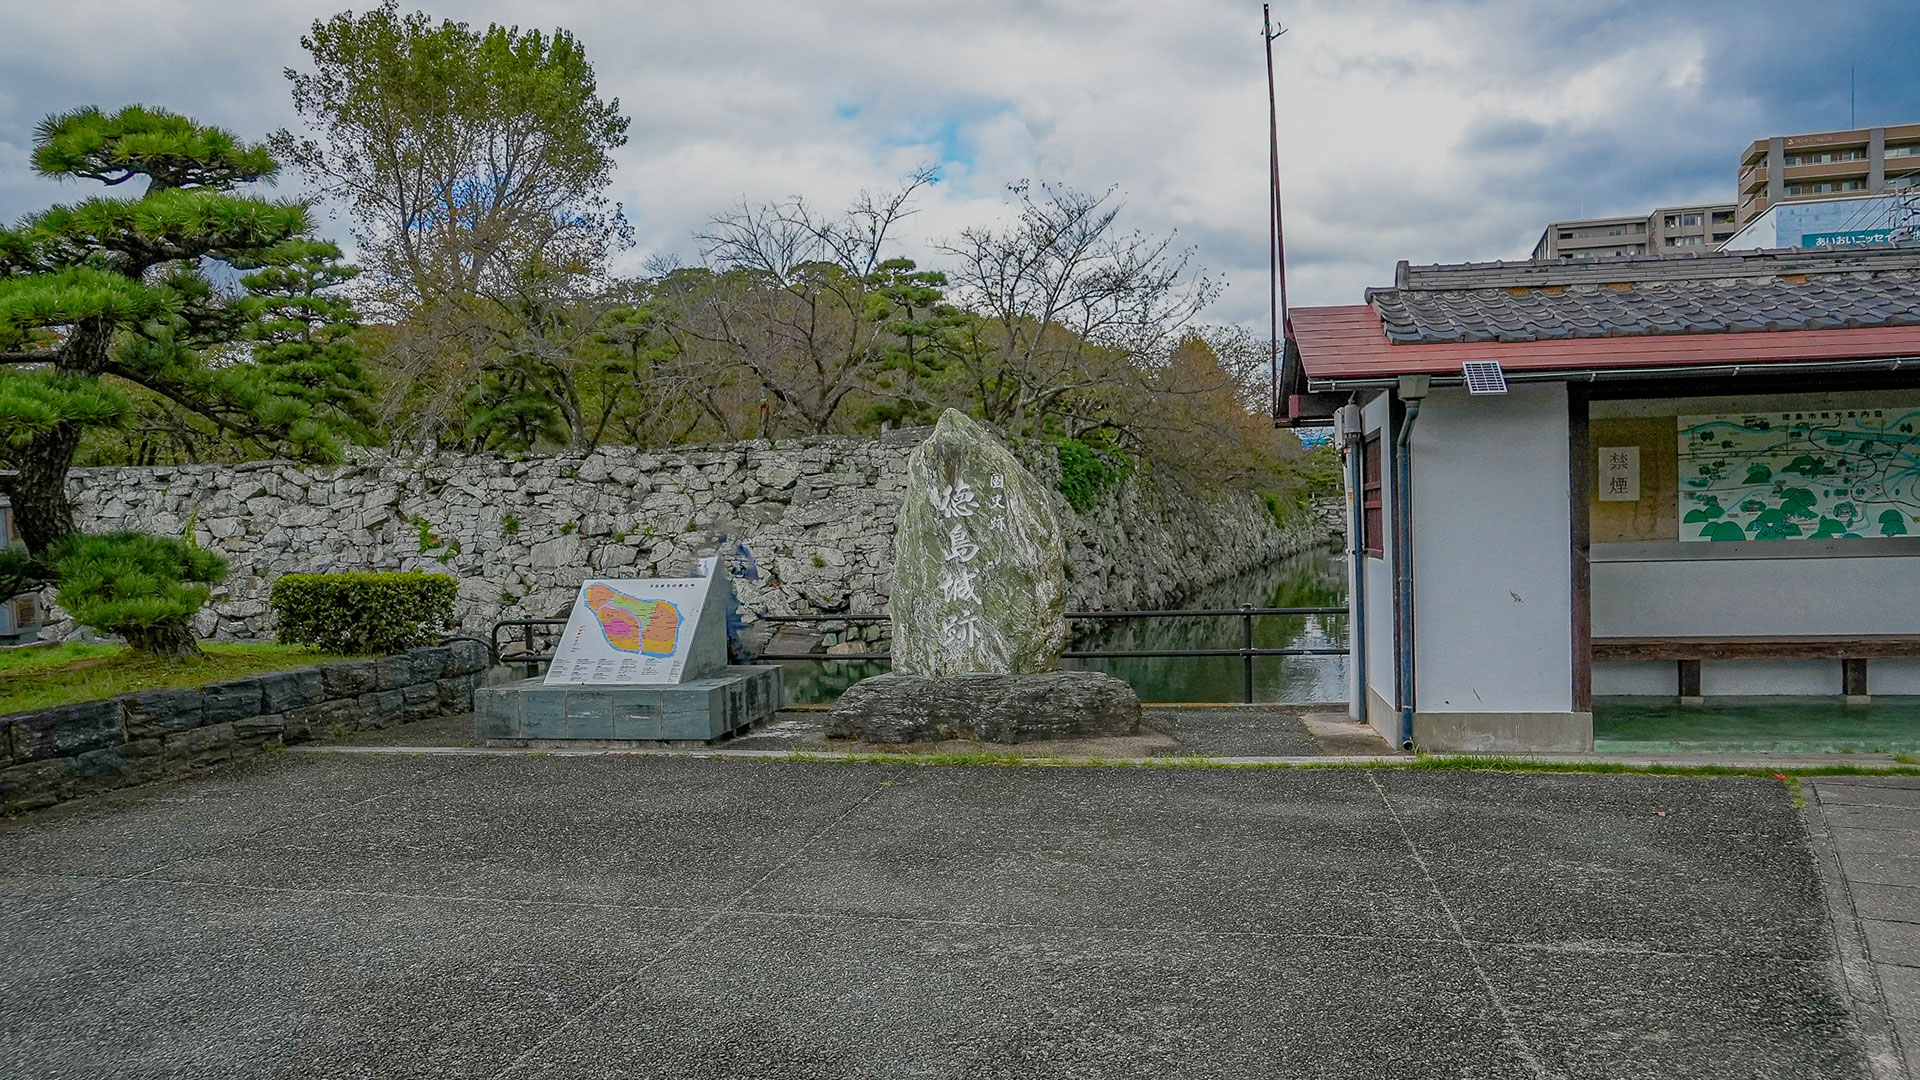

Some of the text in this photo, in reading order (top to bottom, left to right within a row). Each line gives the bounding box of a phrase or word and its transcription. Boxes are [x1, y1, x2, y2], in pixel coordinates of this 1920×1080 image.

[1609, 452, 1628, 494] 禁煙
[938, 478, 982, 648] 徳島城跡
